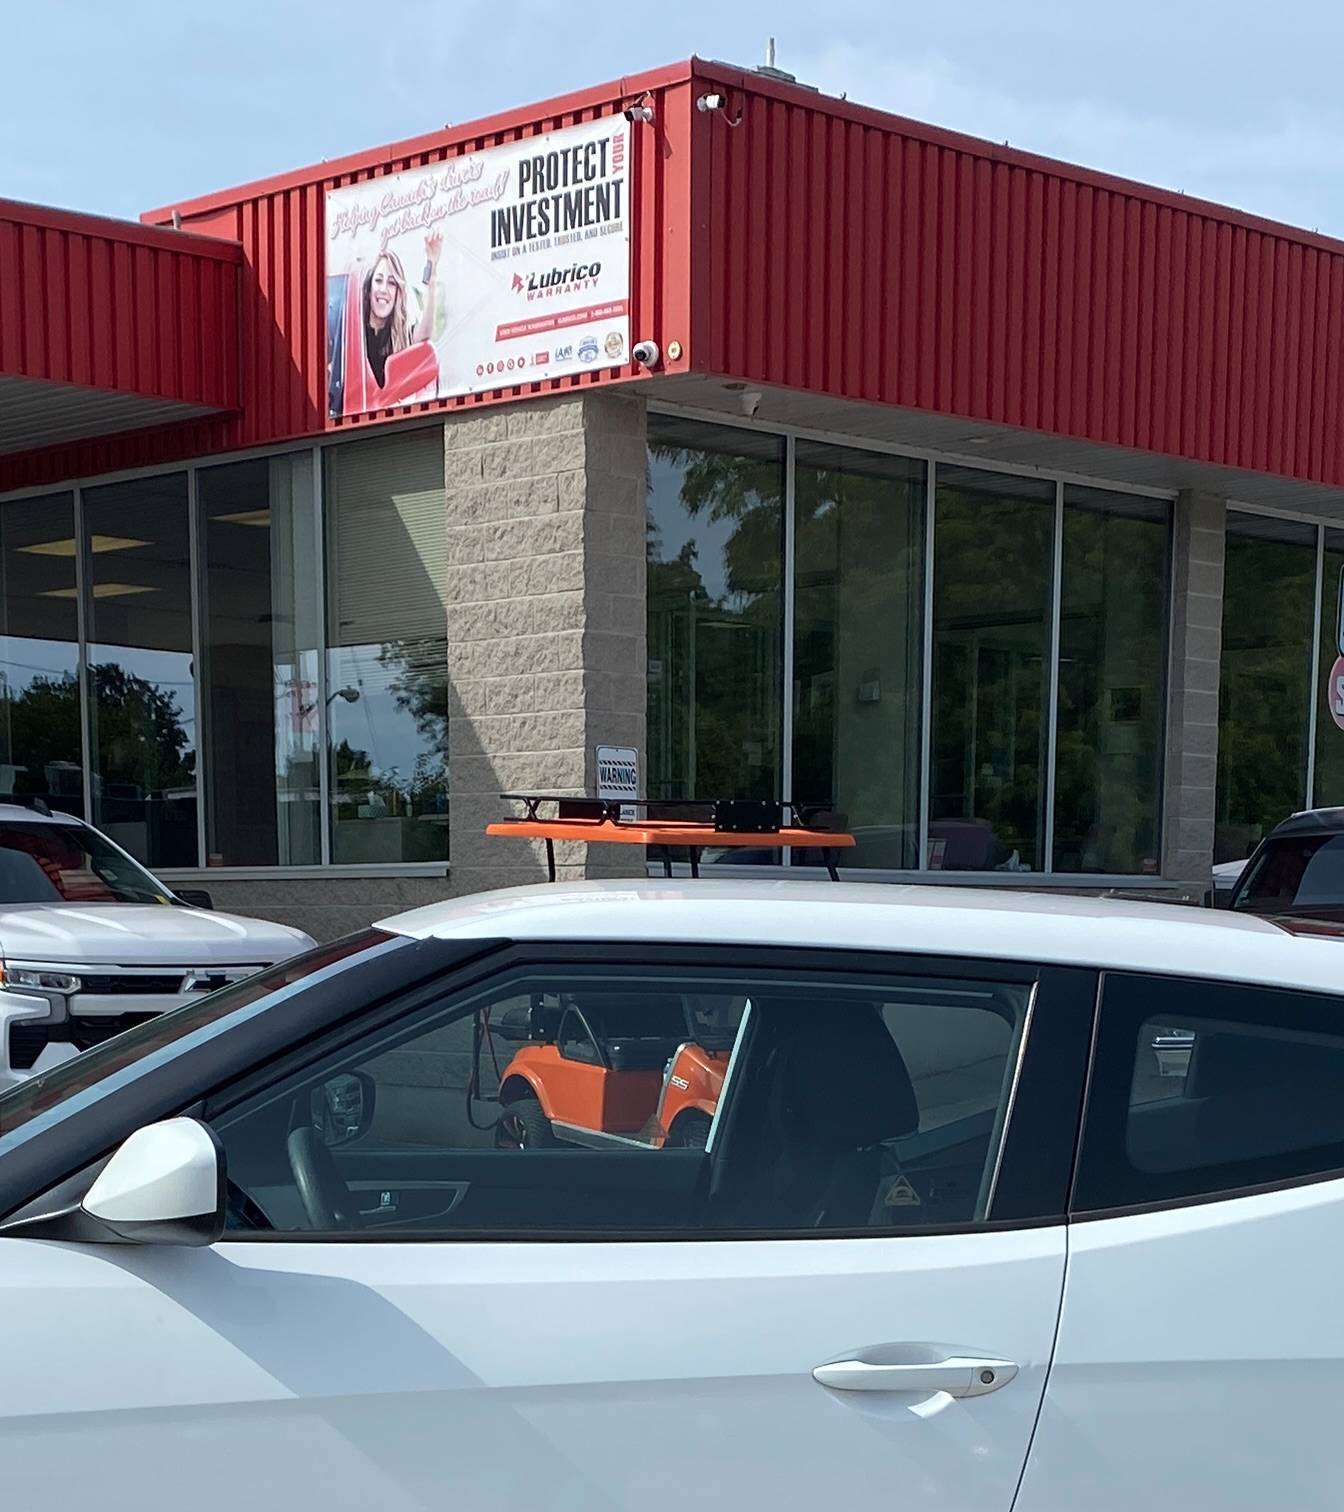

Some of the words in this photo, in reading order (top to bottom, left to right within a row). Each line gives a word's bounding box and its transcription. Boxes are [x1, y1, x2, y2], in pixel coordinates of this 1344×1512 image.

[518, 137, 610, 198] PROTECT
[612, 132, 624, 174] YOUR
[491, 178, 624, 248] INVESTMENT
[526, 278, 600, 302] WARRANTY
[527, 261, 602, 292] Lubrico
[599, 766, 637, 785] WARNING
